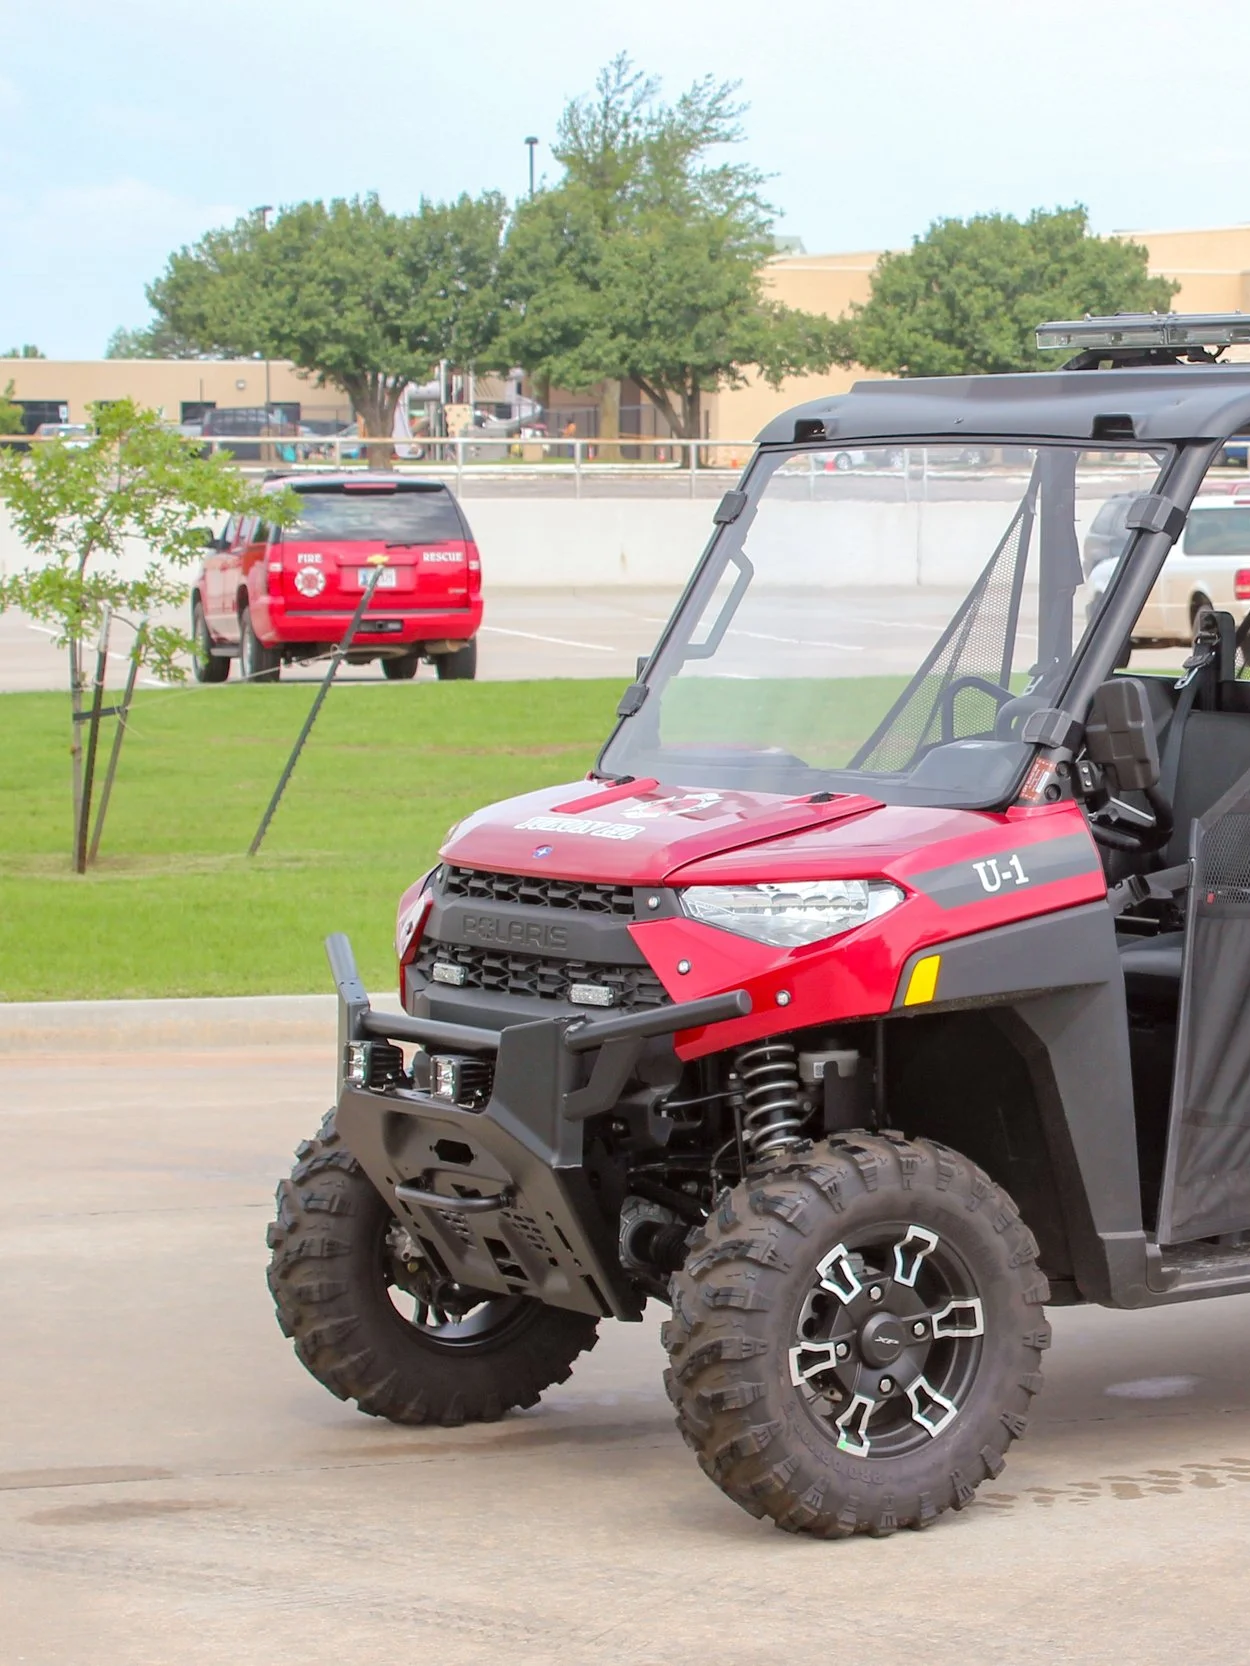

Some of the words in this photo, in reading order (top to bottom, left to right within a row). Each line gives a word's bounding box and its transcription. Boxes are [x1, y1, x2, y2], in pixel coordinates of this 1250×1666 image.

[297, 553, 323, 564] FIRE
[423, 552, 464, 563] RESCUE
[972, 854, 1029, 892] U-1
[462, 914, 568, 951] POLARIS
